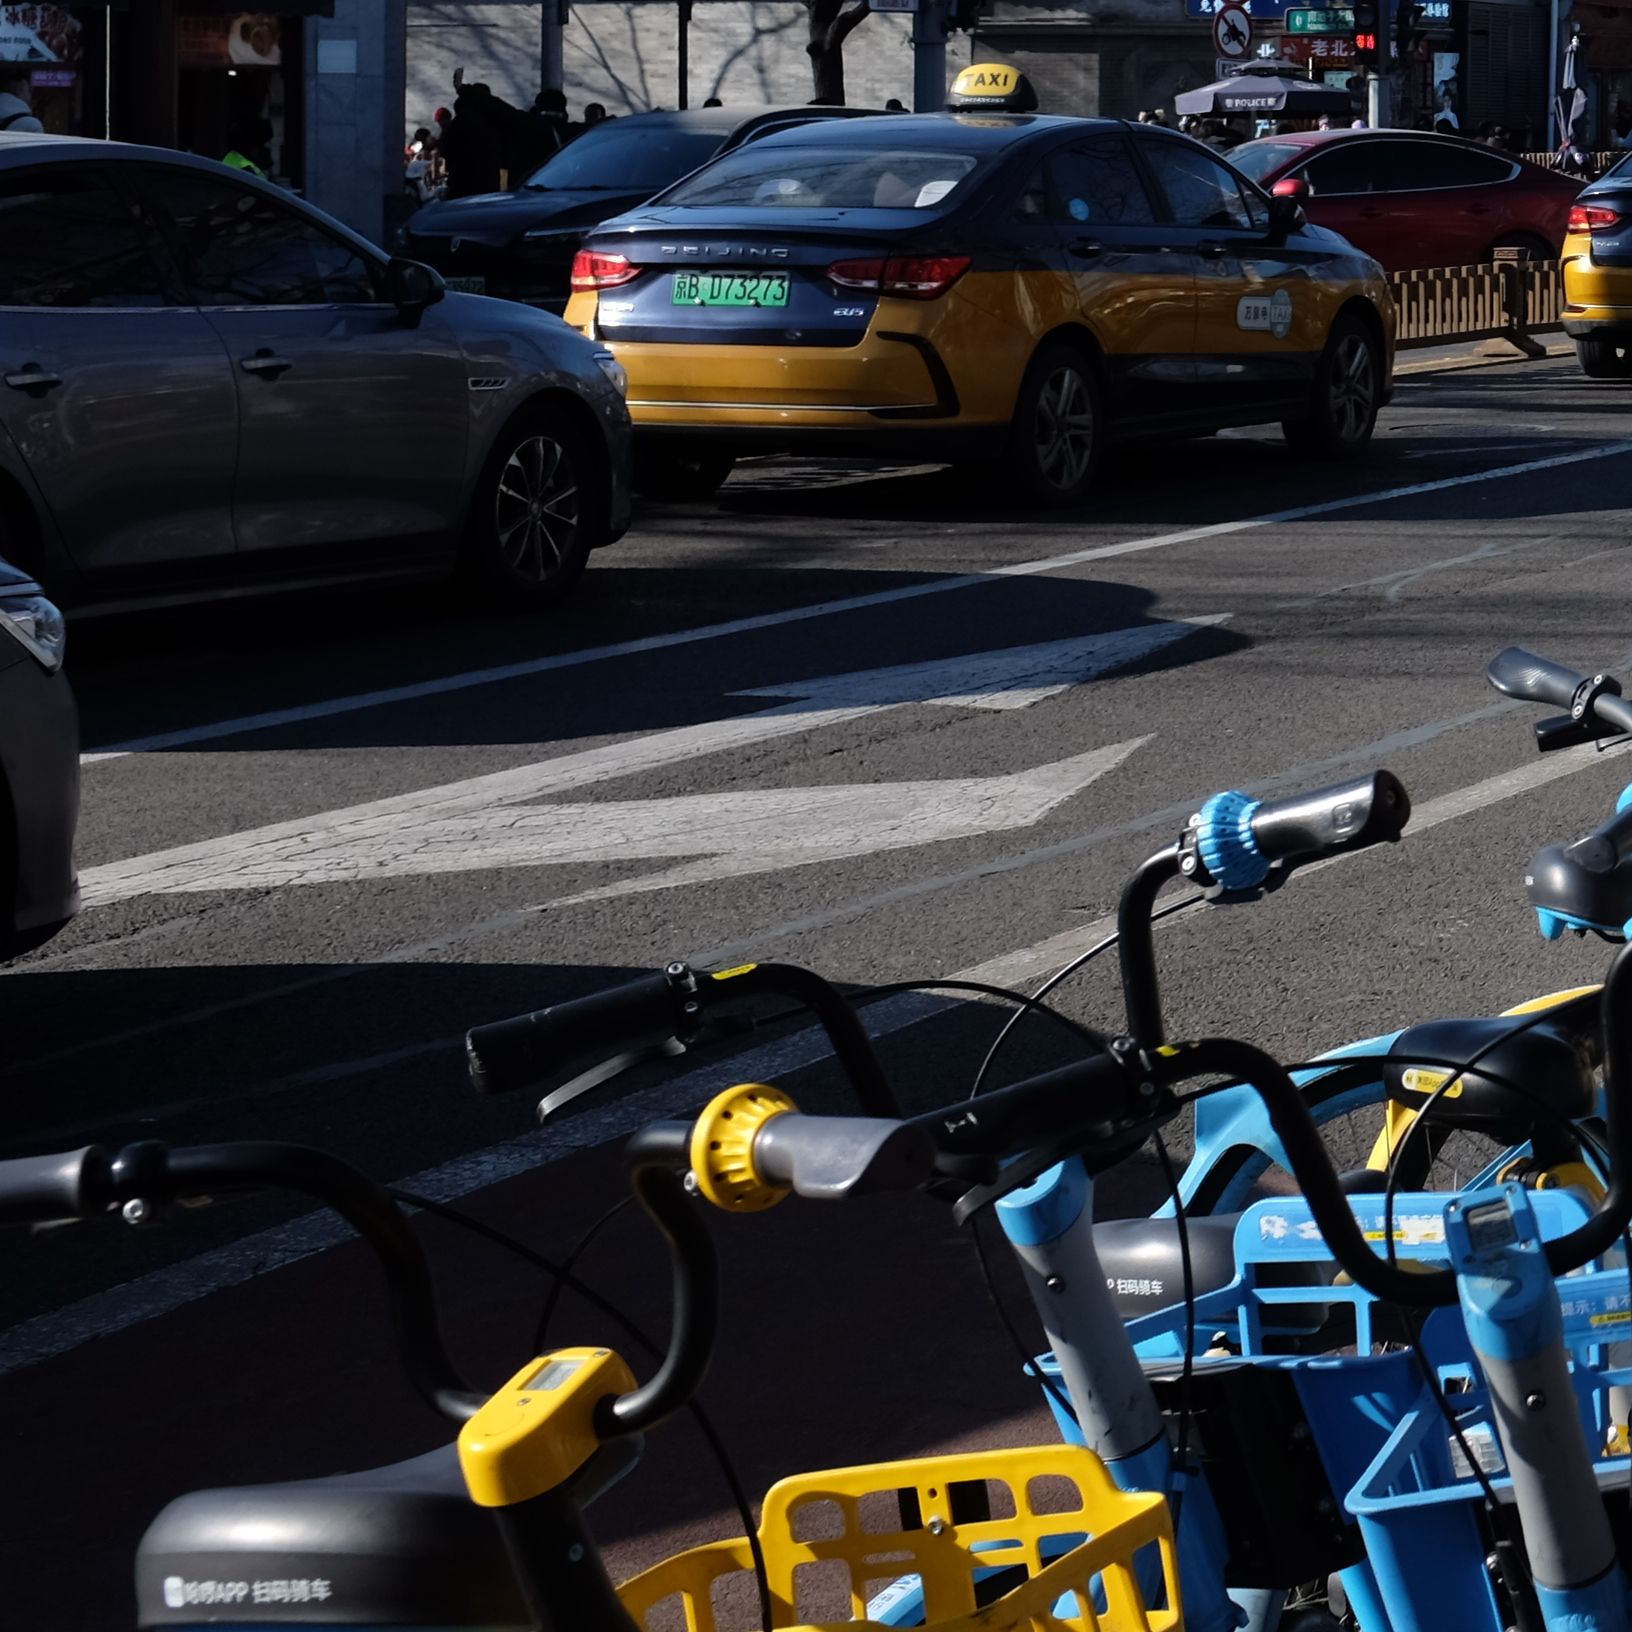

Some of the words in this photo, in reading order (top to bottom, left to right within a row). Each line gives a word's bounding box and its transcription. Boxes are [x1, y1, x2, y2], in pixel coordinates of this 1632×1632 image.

[1311, 37, 1356, 57] 老北
[965, 72, 1009, 87] TAXI
[1234, 97, 1266, 108] POLICE
[252, 1578, 333, 1604] 扫码骑车
